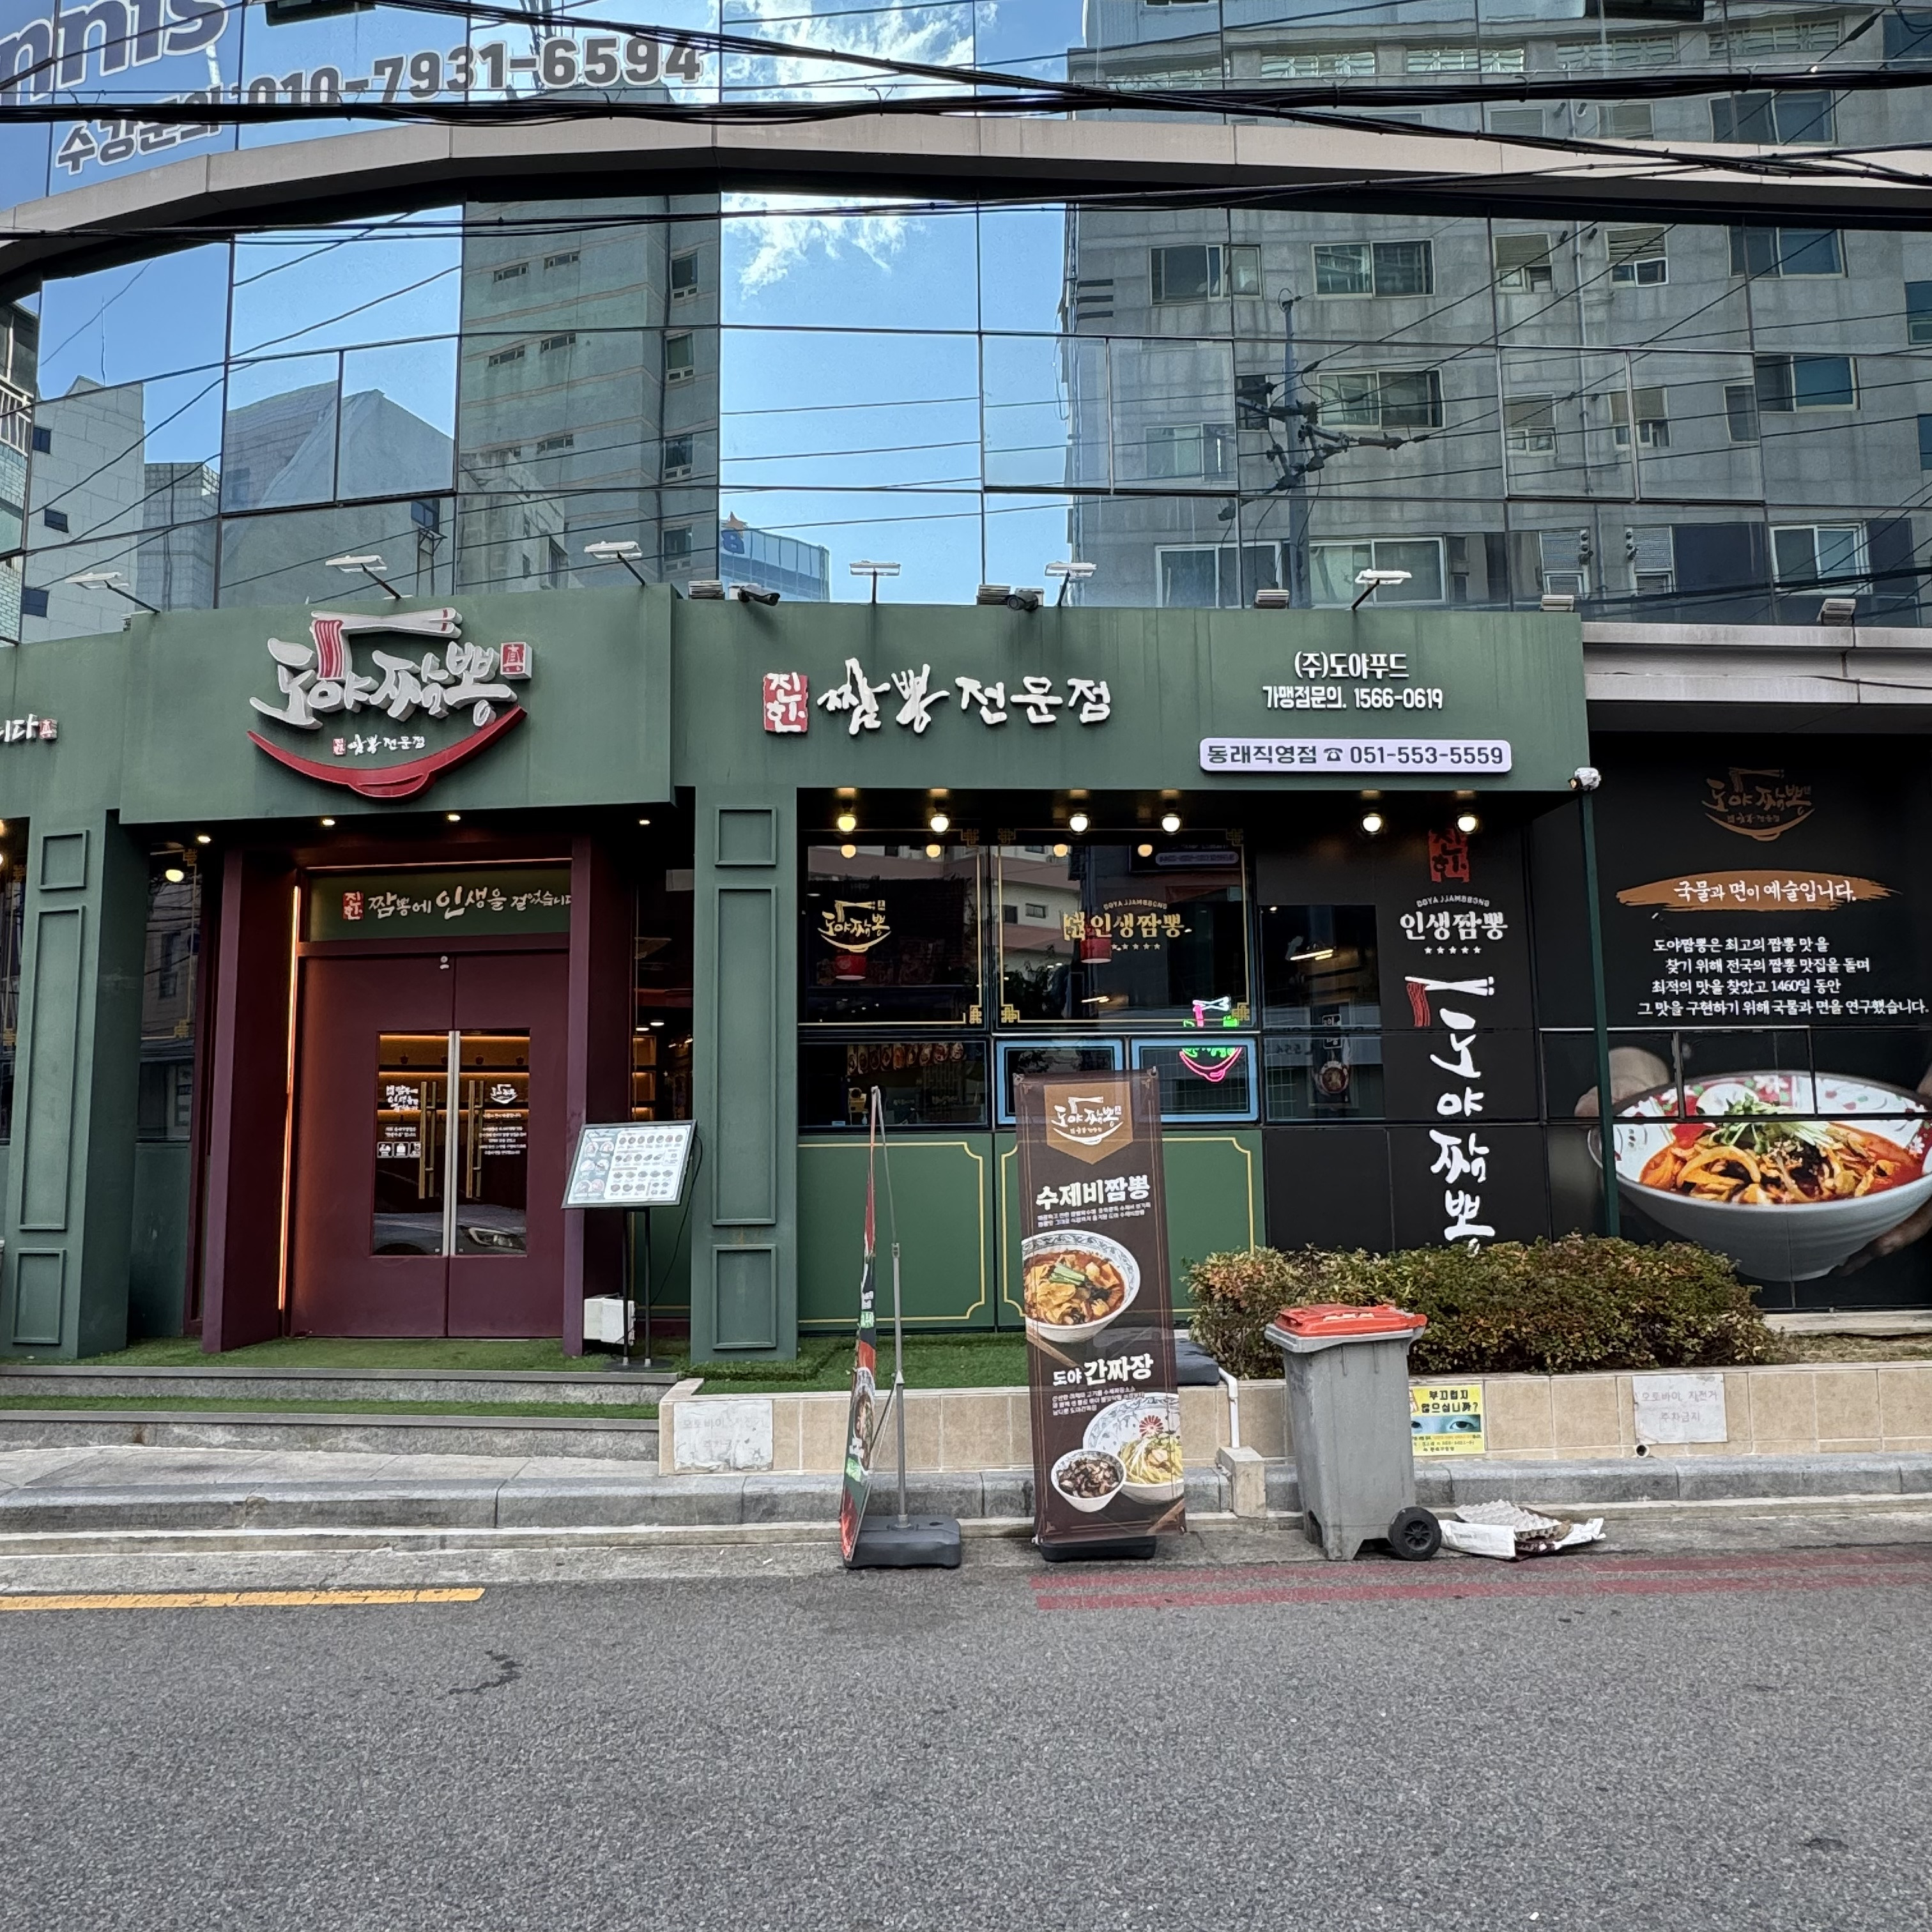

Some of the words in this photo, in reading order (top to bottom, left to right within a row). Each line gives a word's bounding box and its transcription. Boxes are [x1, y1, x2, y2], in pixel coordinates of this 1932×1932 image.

[1294, 650, 1410, 680] (주)도야푸드
[955, 676, 1112, 724] 전문점
[1353, 687, 1443, 709] 1566-0619
[1208, 745, 1317, 765] 동래직영점
[1349, 746, 1504, 765] 051-553-5559
[368, 891, 432, 919] 짬뽕에
[436, 885, 507, 920] 인생을
[1673, 880, 1726, 903] 국물과
[1729, 880, 1761, 902] 면이
[1764, 880, 1857, 901] 예술입니다.
[1090, 912, 1185, 939] 인생짬뽕
[1399, 910, 1509, 940] 인생짬뽕
[1653, 937, 1723, 953] 도야짬뽕은
[1725, 937, 1765, 953] 최고의
[1767, 937, 1797, 953] 짬뽕
[1666, 958, 1692, 974] 찾기
[1696, 958, 1722, 974] 위해
[1726, 958, 1765, 974] 전국의
[1768, 958, 1797, 974] 짬뽕
[1799, 958, 1840, 974] 맛집을
[1843, 958, 1870, 974] 돌며
[1652, 979, 1692, 995] 최적의
[1696, 979, 1724, 995] 맛을
[1726, 979, 1769, 995] 찾았고
[1771, 979, 1811, 995] 1460일
[1814, 979, 1841, 995] 동안
[1637, 999, 1653, 1017] 그
[1655, 999, 1683, 1017] 맛을
[1685, 999, 1739, 1017] 구현하기
[1742, 999, 1770, 1017] 위해
[1771, 999, 1814, 1017] 국물과
[1816, 999, 1843, 1017] 면을
[1845, 999, 1929, 1017] 연구했습니다.
[1035, 1174, 1151, 1211] 수제비짬뽕
[1052, 1367, 1082, 1387] 도야
[1084, 1353, 1154, 1386] 간짜장
